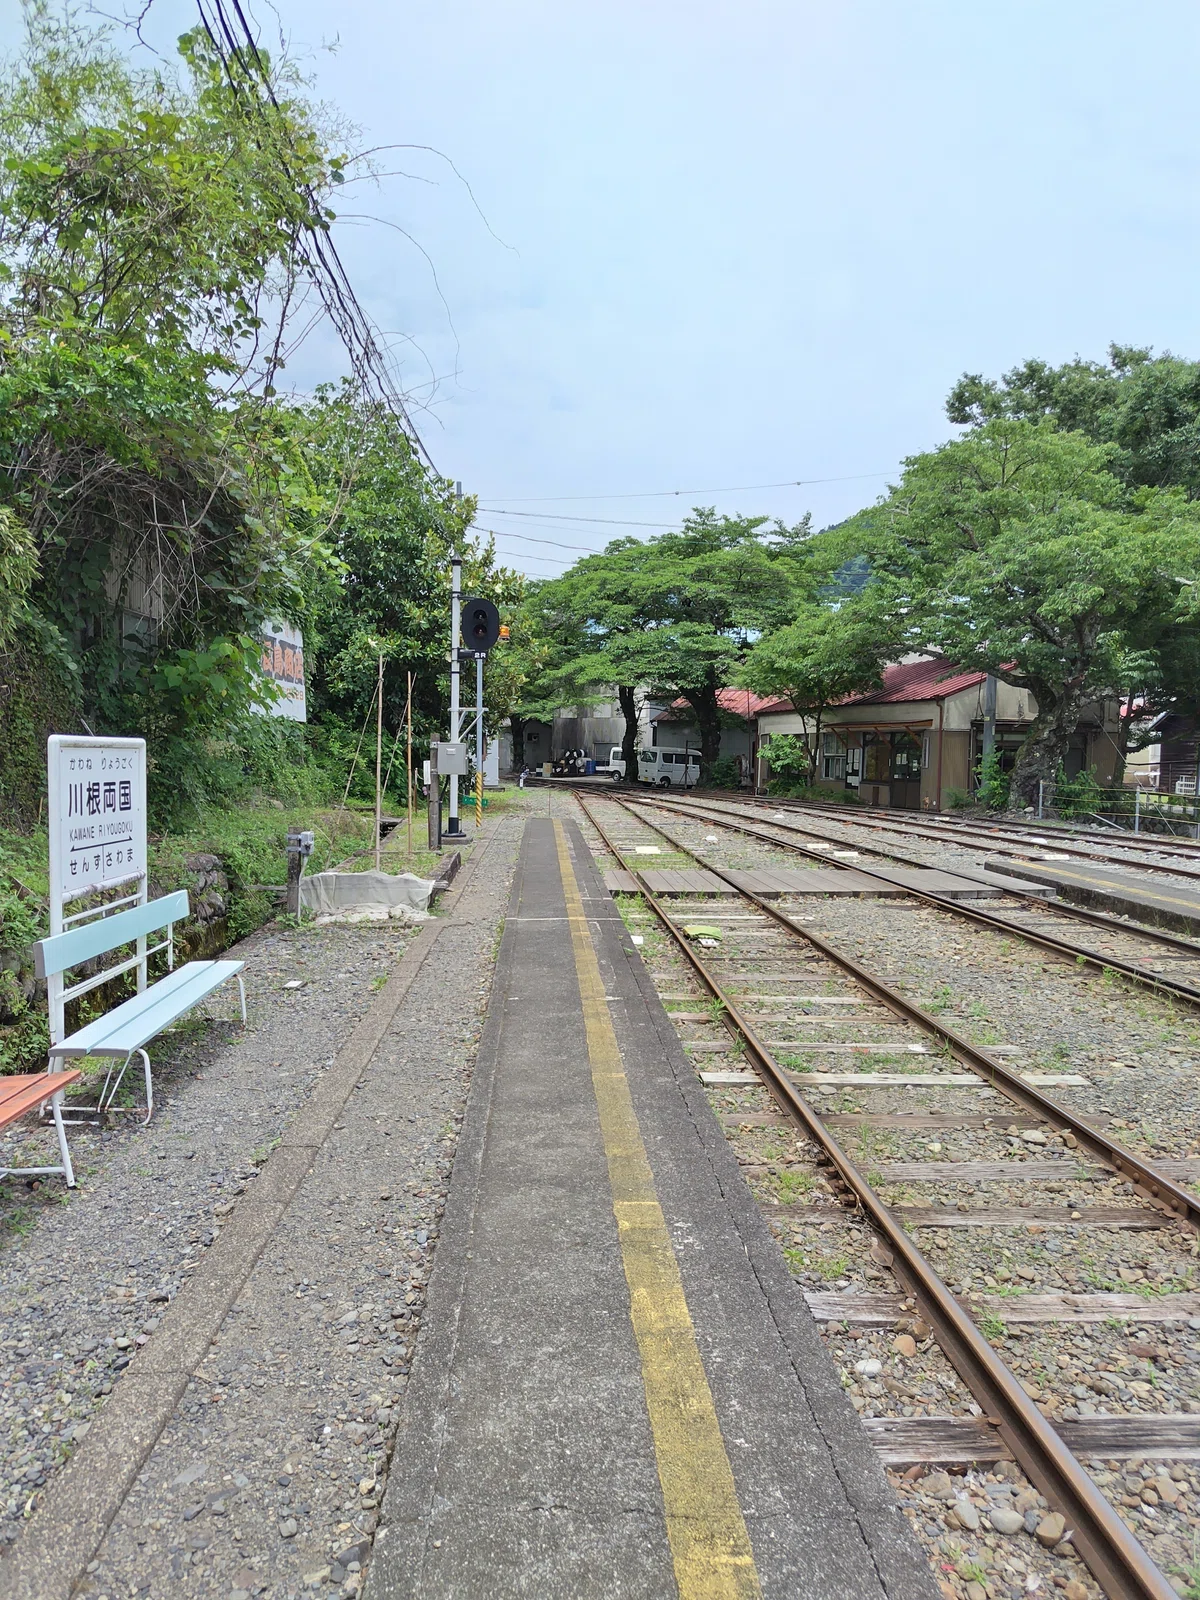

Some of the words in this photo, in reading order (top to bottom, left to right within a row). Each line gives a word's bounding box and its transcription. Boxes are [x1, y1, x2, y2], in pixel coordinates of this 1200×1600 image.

[69, 757, 93, 771] かわね
[101, 757, 133, 770] りょうごく
[68, 780, 132, 817] 川根両国
[69, 826, 95, 842] KAWANE
[105, 847, 134, 867] さわま
